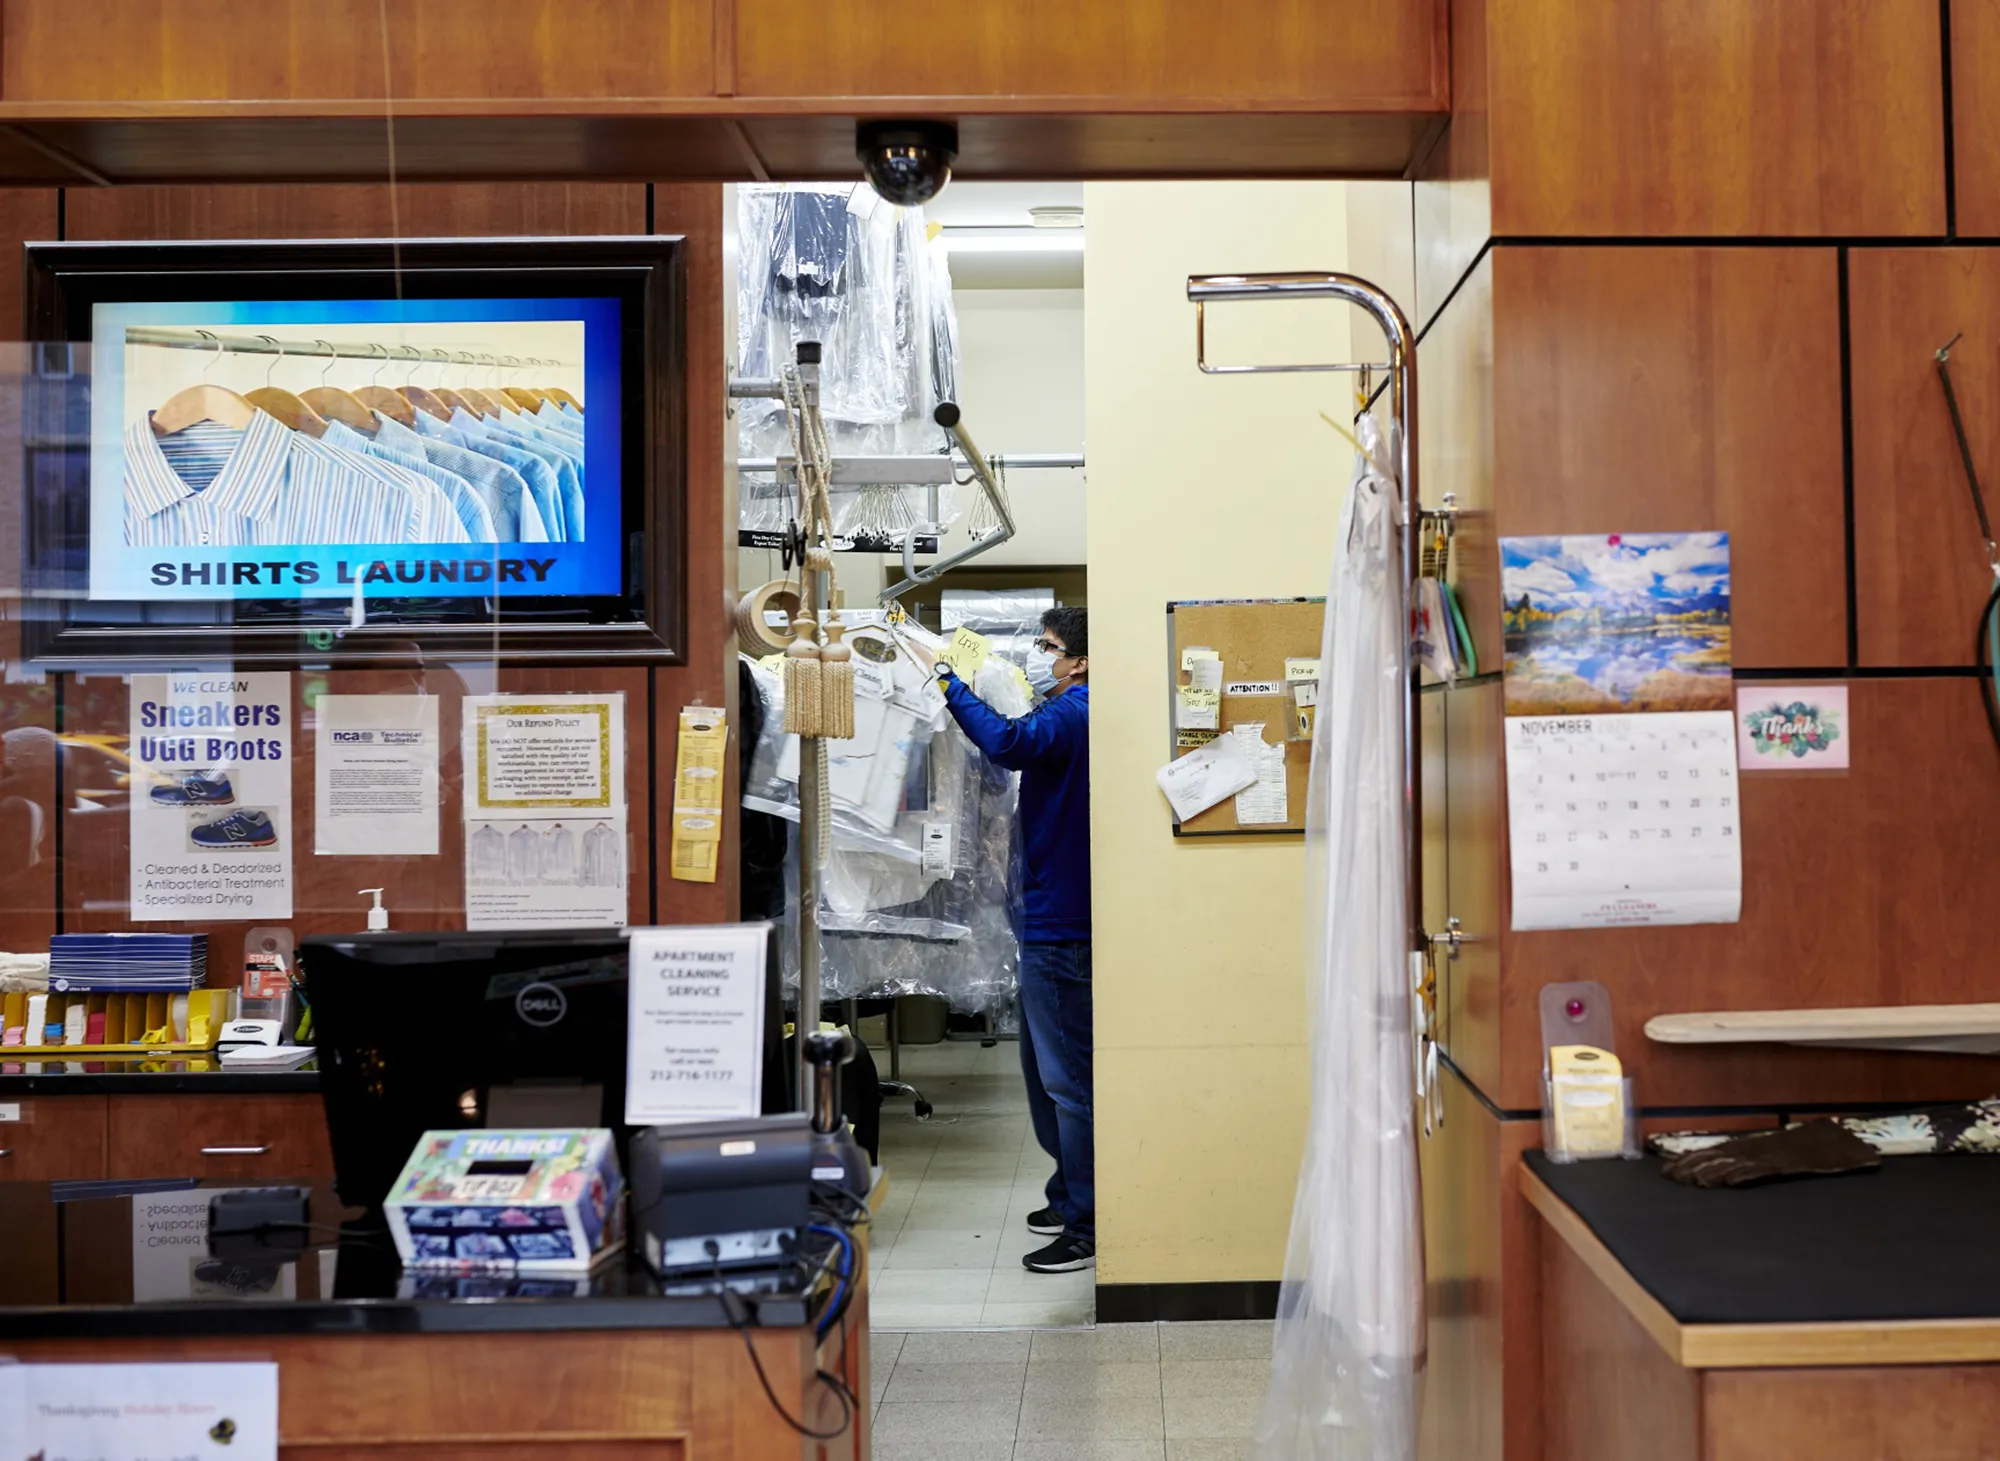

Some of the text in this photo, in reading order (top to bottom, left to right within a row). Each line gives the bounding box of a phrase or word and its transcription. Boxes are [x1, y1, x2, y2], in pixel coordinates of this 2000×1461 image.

[150, 558, 557, 585] SHIRTS LAUNDRY
[174, 681, 248, 693] WE CLEAN
[140, 701, 281, 727] Sneakers
[555, 719, 580, 727] POLICY
[1521, 720, 1592, 735] NOVEMBER
[1761, 716, 1823, 737] Thanks
[334, 732, 360, 741] nca
[140, 737, 282, 762] UGG Boots
[145, 865, 198, 876] Cleaned
[201, 864, 209, 874] &
[213, 862, 282, 875] Deodorized
[145, 879, 221, 890] Antibacterial
[224, 878, 285, 890] Treatment
[144, 893, 213, 905] Specialized
[215, 892, 253, 905] Drying
[653, 951, 735, 962] APARTMENT
[660, 969, 729, 980] CLEANING
[668, 986, 721, 997] SERVICE
[522, 998, 560, 1011] DELL
[465, 1138, 569, 1154] THANKS!
